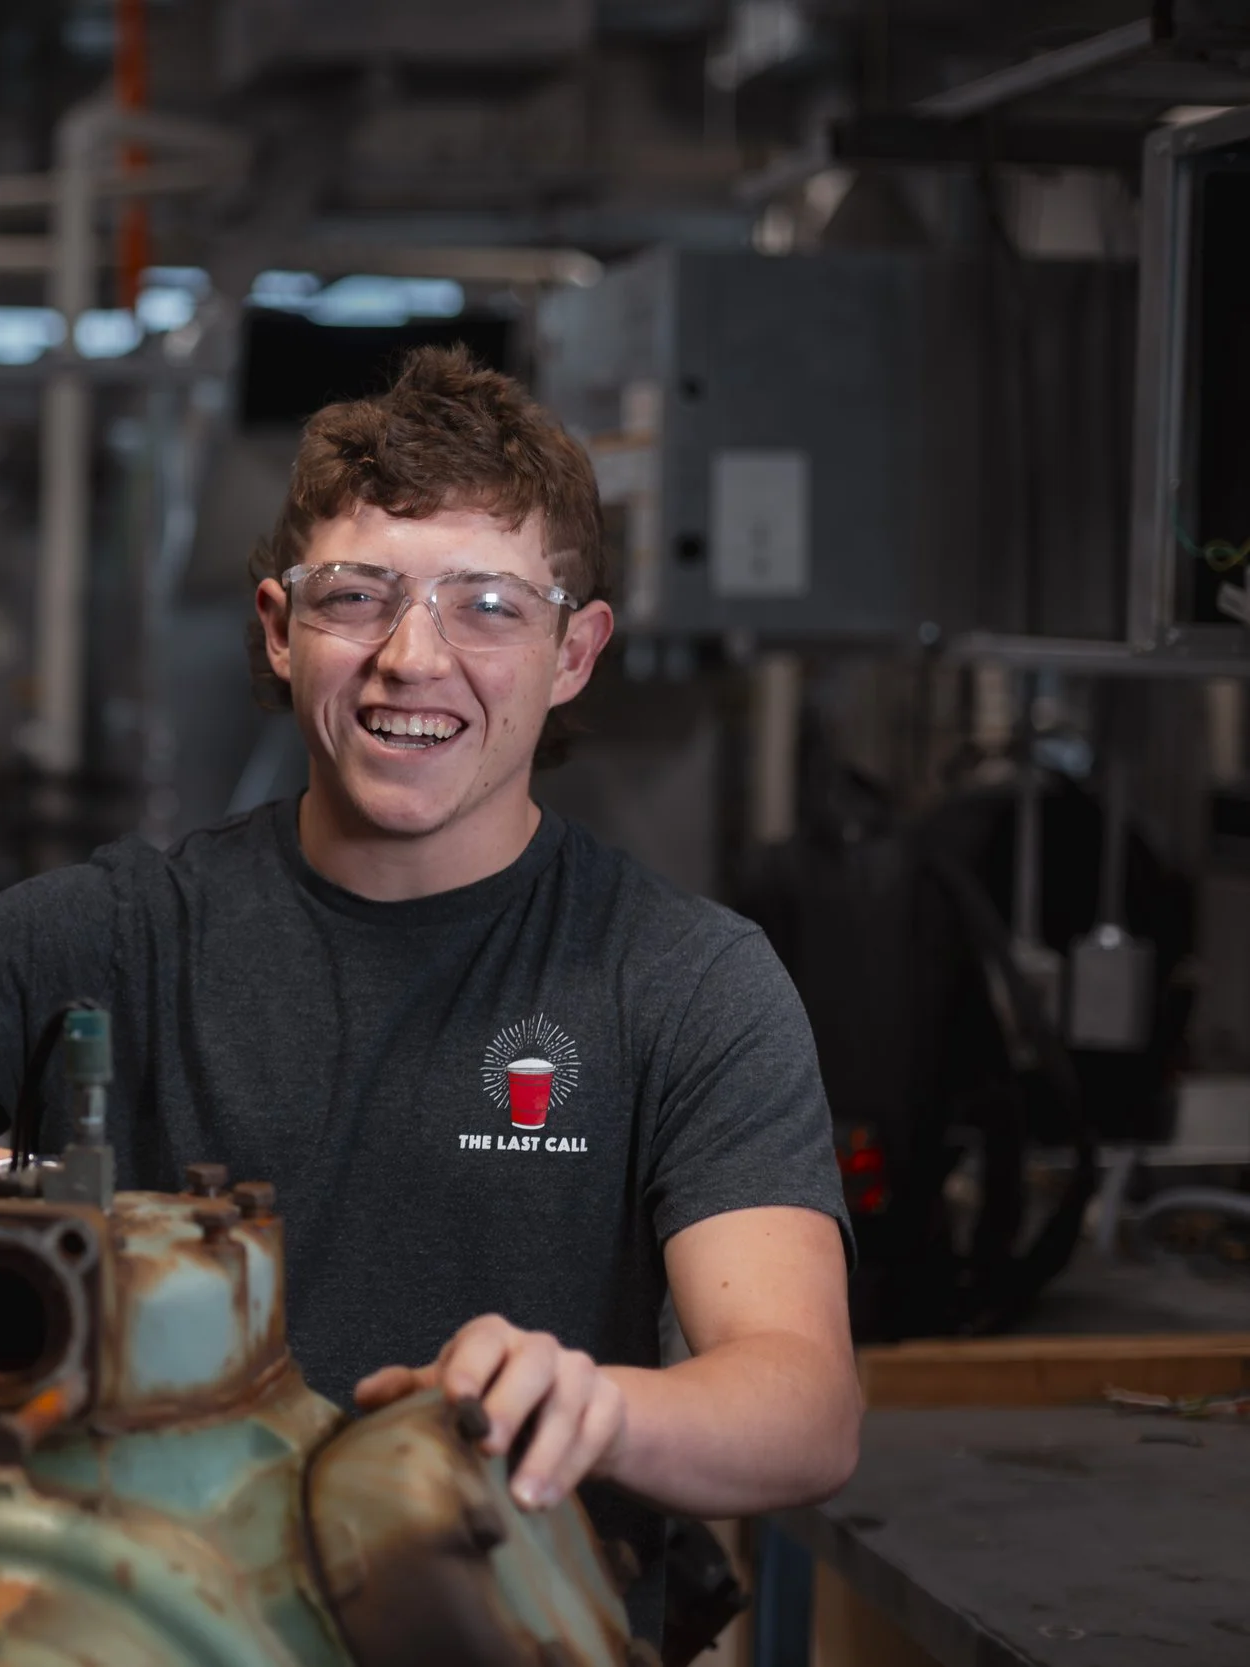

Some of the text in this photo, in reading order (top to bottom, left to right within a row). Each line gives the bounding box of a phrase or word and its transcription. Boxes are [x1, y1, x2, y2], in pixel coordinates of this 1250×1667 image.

[458, 1134, 588, 1152] THE LAST CALL
